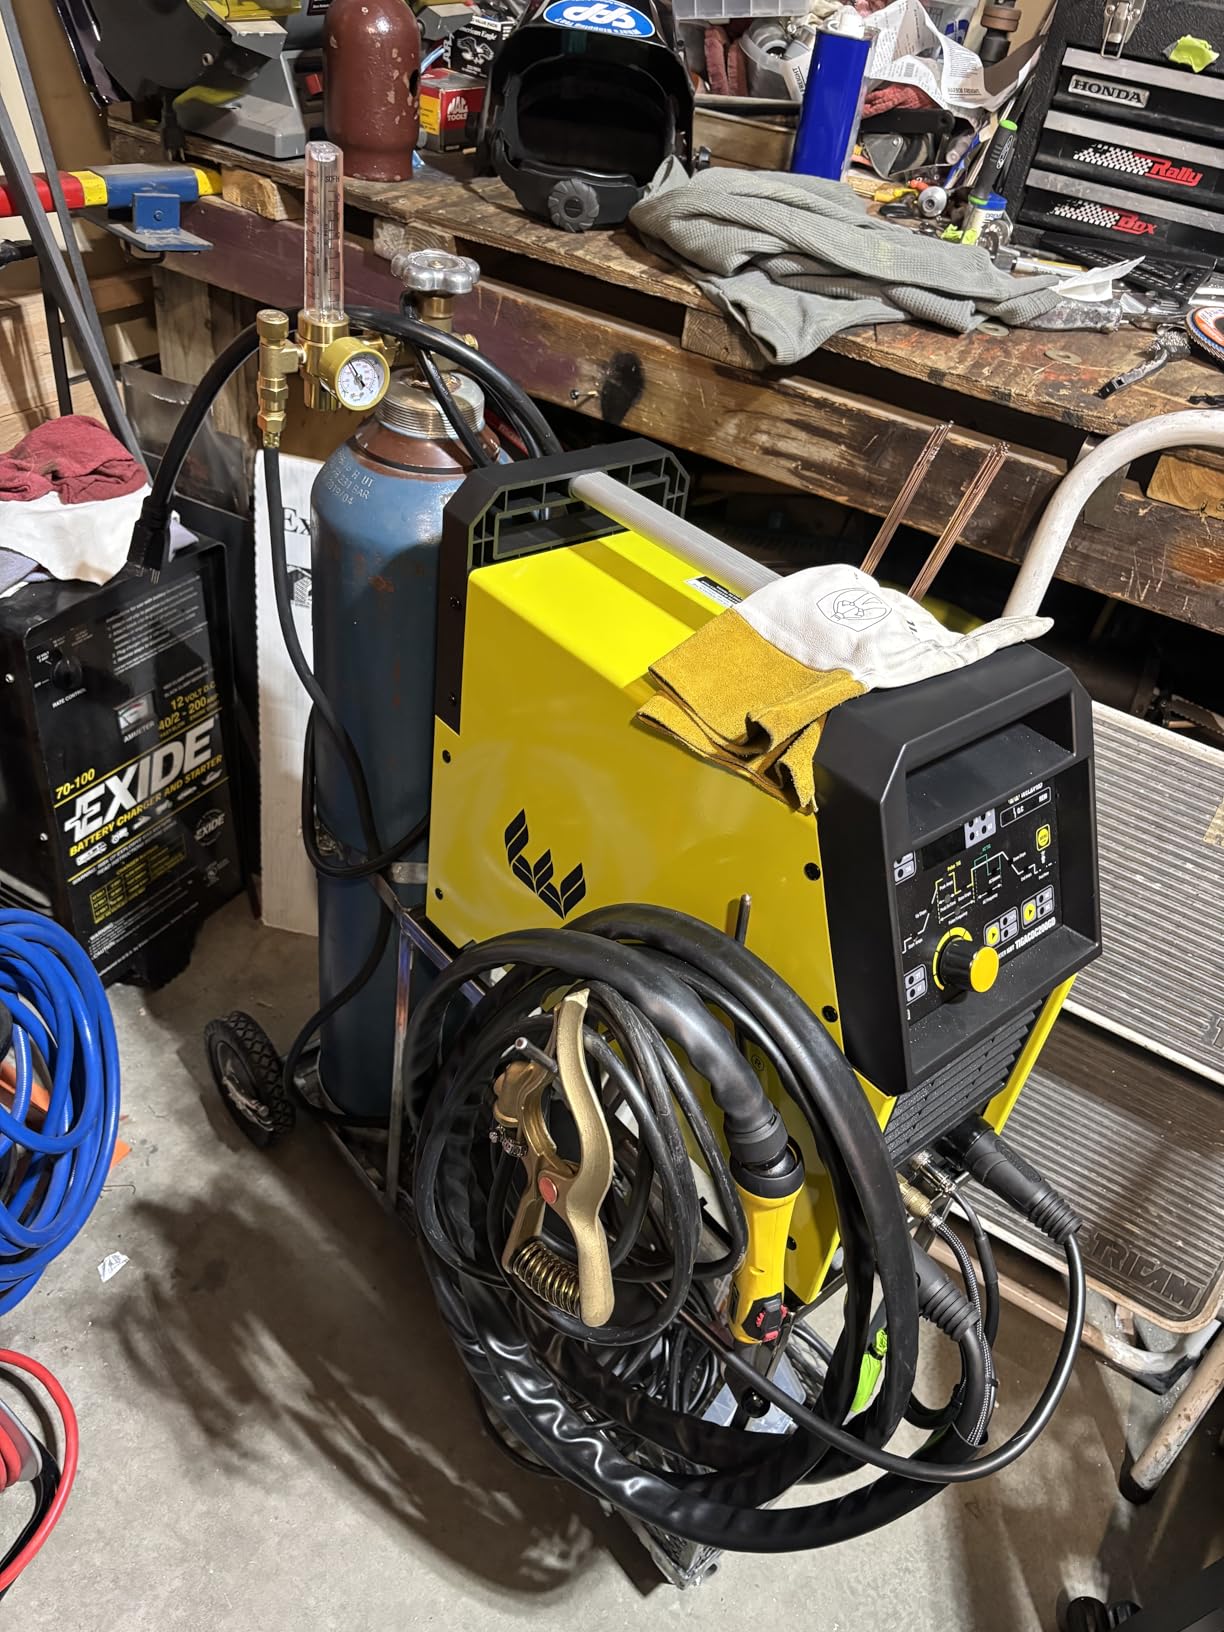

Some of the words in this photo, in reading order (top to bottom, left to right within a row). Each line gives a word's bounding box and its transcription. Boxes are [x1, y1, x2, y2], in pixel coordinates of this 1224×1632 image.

[481, 30, 498, 41] Eagle
[1072, 78, 1144, 104] HONDA
[446, 95, 469, 115] MAC
[447, 112, 468, 121] TOOLS
[1147, 156, 1204, 187] Rally
[1116, 211, 1159, 236] Box
[170, 696, 185, 710] 12
[184, 687, 203, 703] VOLT
[158, 711, 181, 731] 40/2
[188, 696, 208, 714] 200
[123, 719, 155, 744] AMMETER
[55, 767, 96, 800] 70-100
[63, 717, 216, 843] EXIDE
[69, 820, 115, 857] BATTERY
[115, 791, 162, 827] CHARGER
[163, 778, 184, 798] AND
[184, 754, 223, 784] STARTER
[194, 813, 225, 841] EXIDE
[1091, 1230, 1203, 1313] TRICAM
